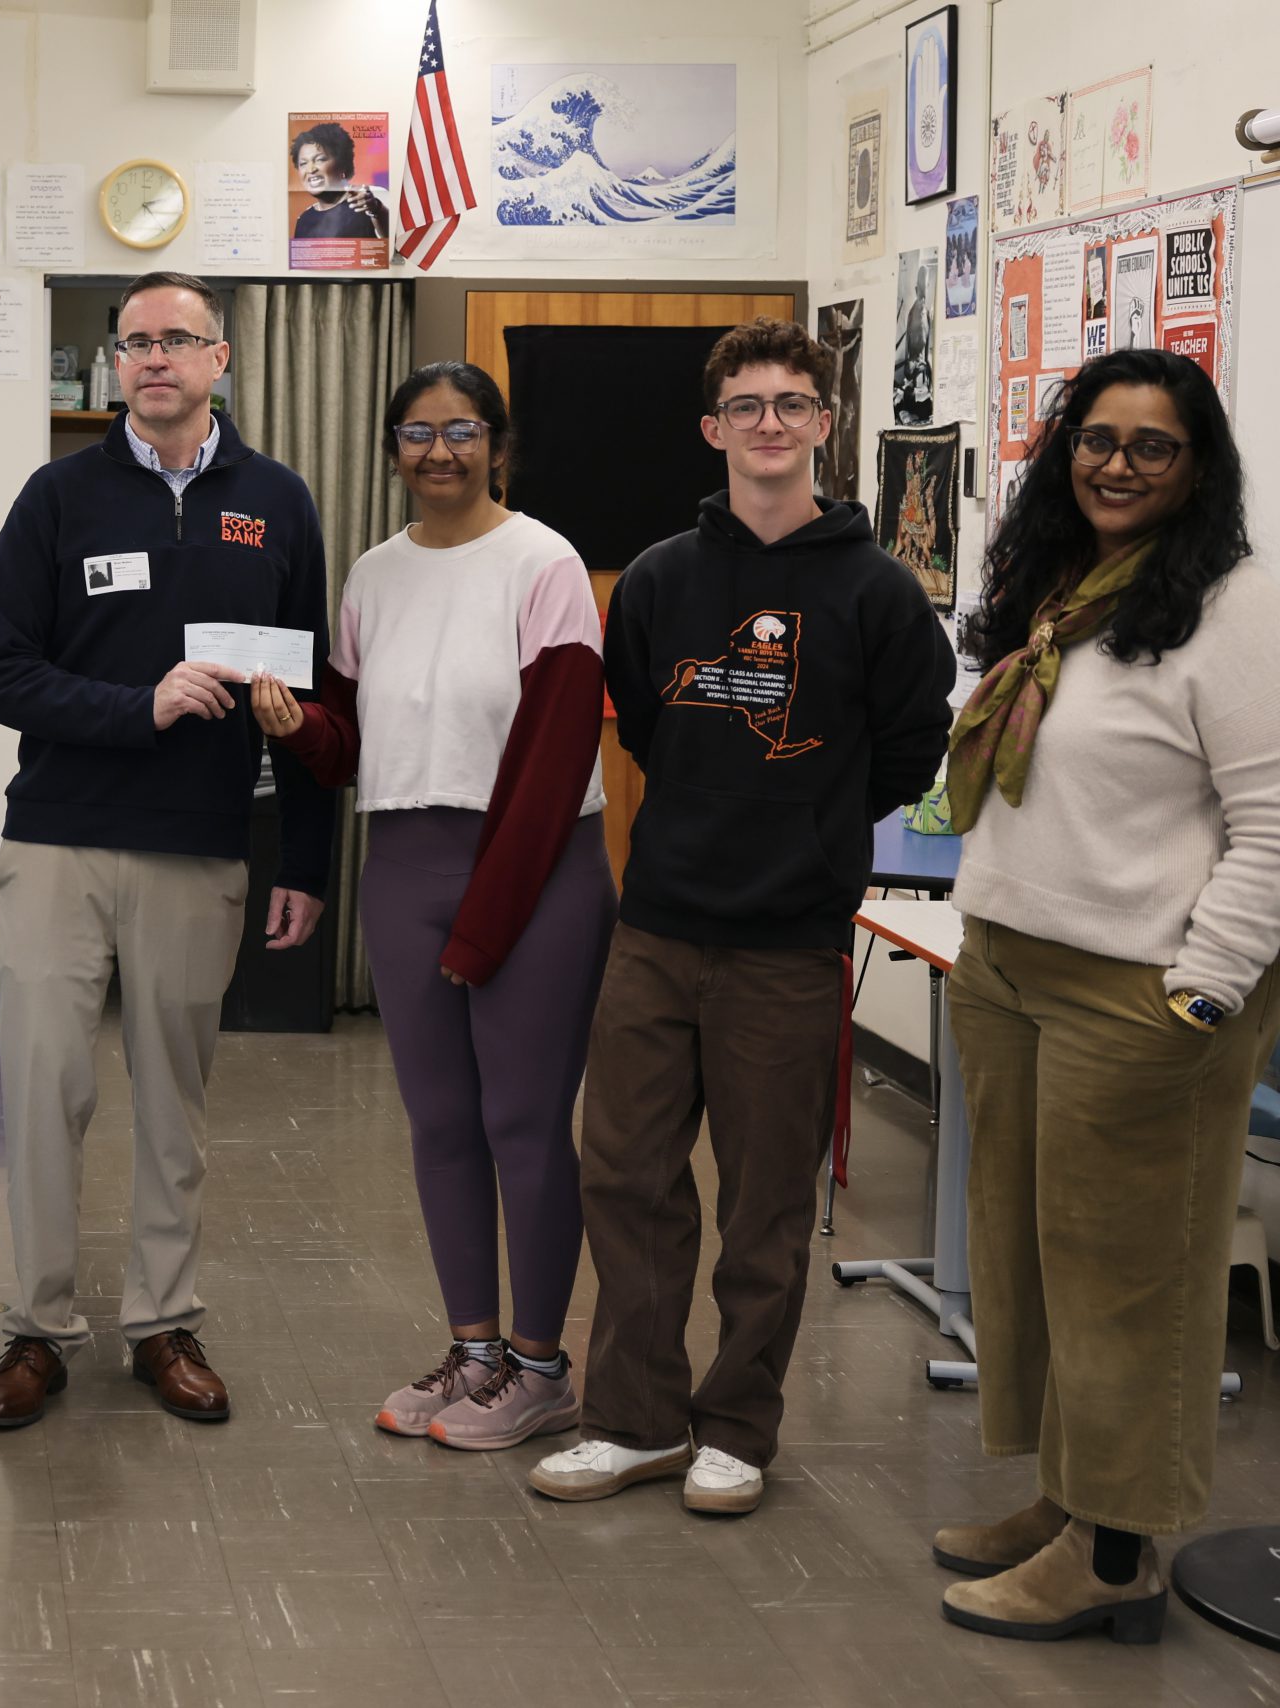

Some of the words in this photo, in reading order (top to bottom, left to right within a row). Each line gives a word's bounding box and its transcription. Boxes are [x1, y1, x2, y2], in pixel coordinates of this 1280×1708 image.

[1173, 232, 1206, 254] PUBLIC
[1118, 258, 1131, 274] DEFEND
[1132, 255, 1152, 272] EQUALITY
[1170, 253, 1207, 276] SCHOOLS
[1168, 275, 1194, 297] UNITE
[1197, 274, 1209, 294] US
[1087, 324, 1106, 347] WE
[1087, 346, 1104, 355] ARE
[1170, 337, 1208, 356] TEACHER
[221, 511, 252, 520] REGIONAL
[221, 516, 266, 534] FOOD
[222, 528, 263, 548] BANK
[751, 642, 783, 651] EAGLES
